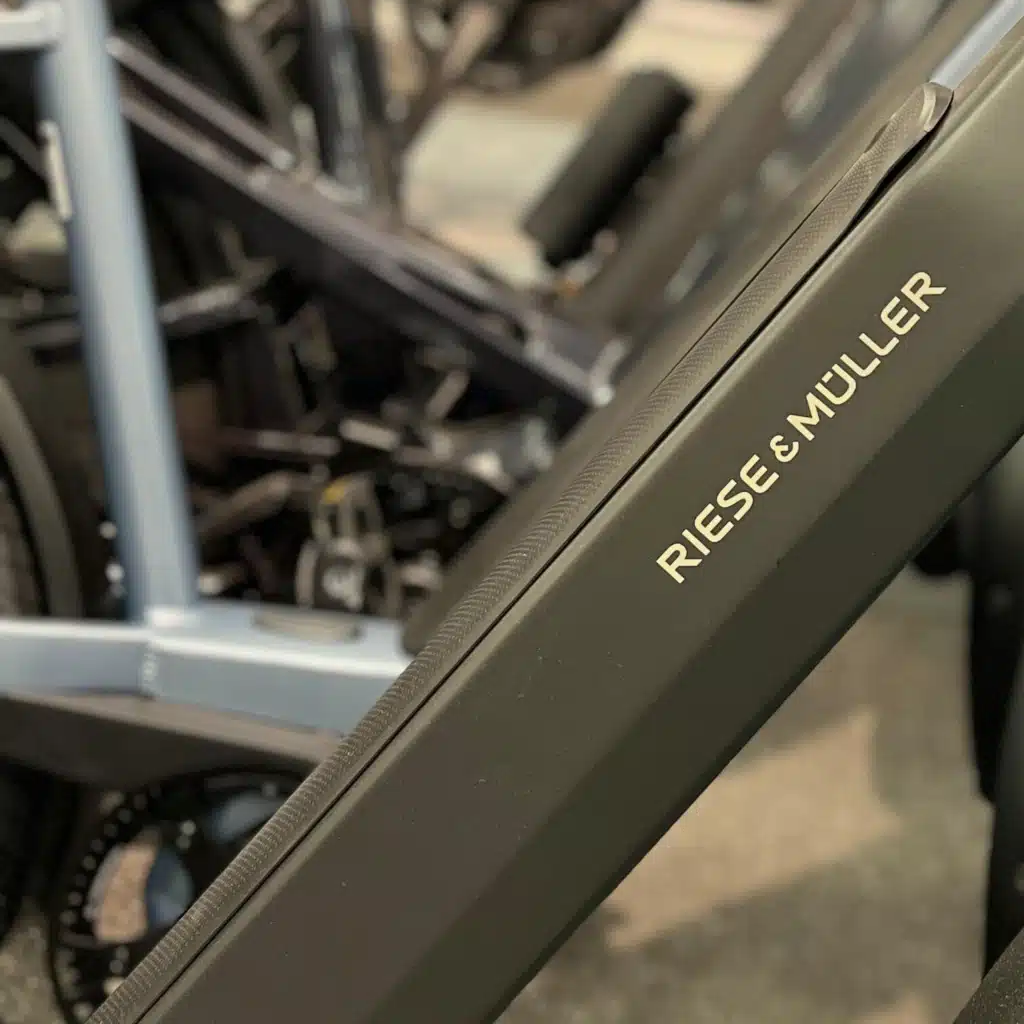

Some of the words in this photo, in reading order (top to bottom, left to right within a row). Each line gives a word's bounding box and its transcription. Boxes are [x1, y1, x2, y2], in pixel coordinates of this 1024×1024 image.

[656, 454, 780, 584] RIESE
[770, 435, 799, 463] &
[786, 272, 947, 441] MÜLLER
